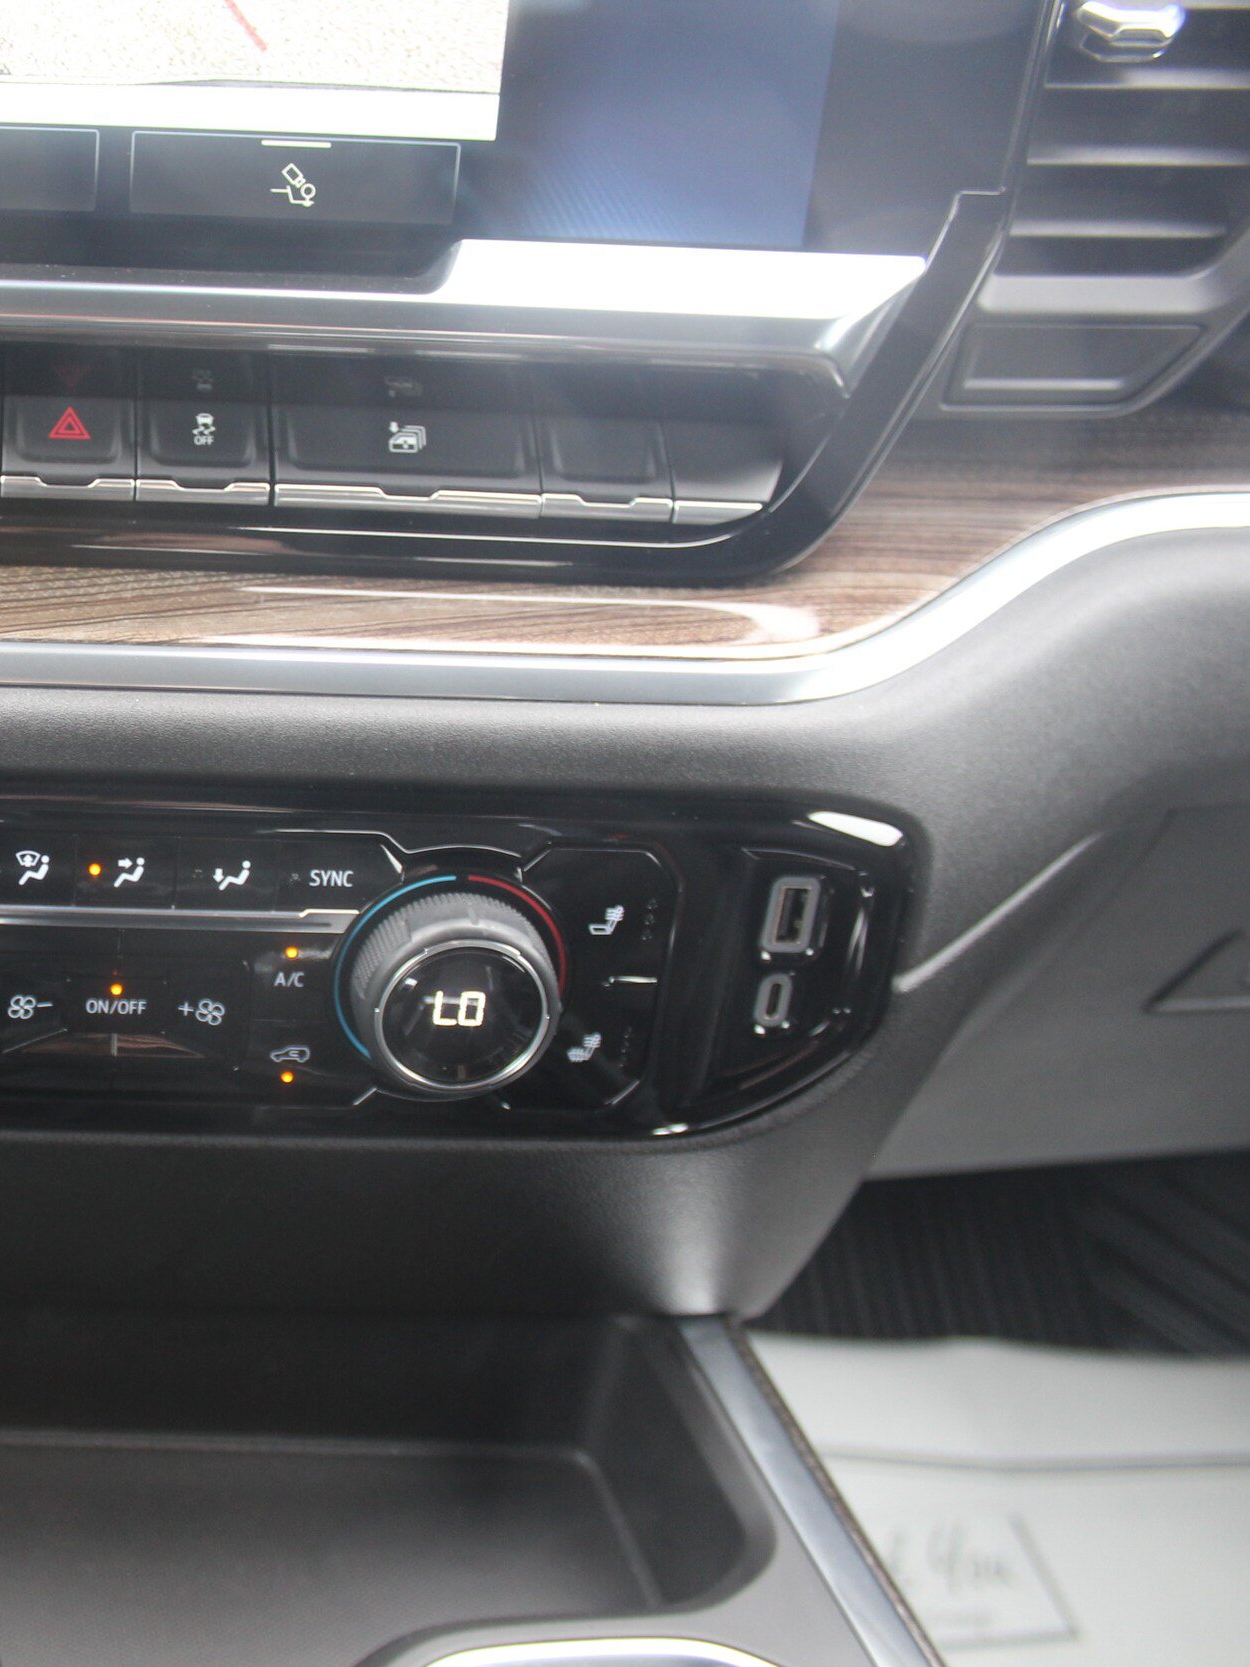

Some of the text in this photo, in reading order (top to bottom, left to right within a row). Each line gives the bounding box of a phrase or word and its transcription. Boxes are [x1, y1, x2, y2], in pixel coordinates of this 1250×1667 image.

[308, 869, 354, 888] SYNC
[273, 970, 305, 988] A/C
[85, 999, 148, 1015] ON/OFF
[432, 990, 487, 1027] LO
